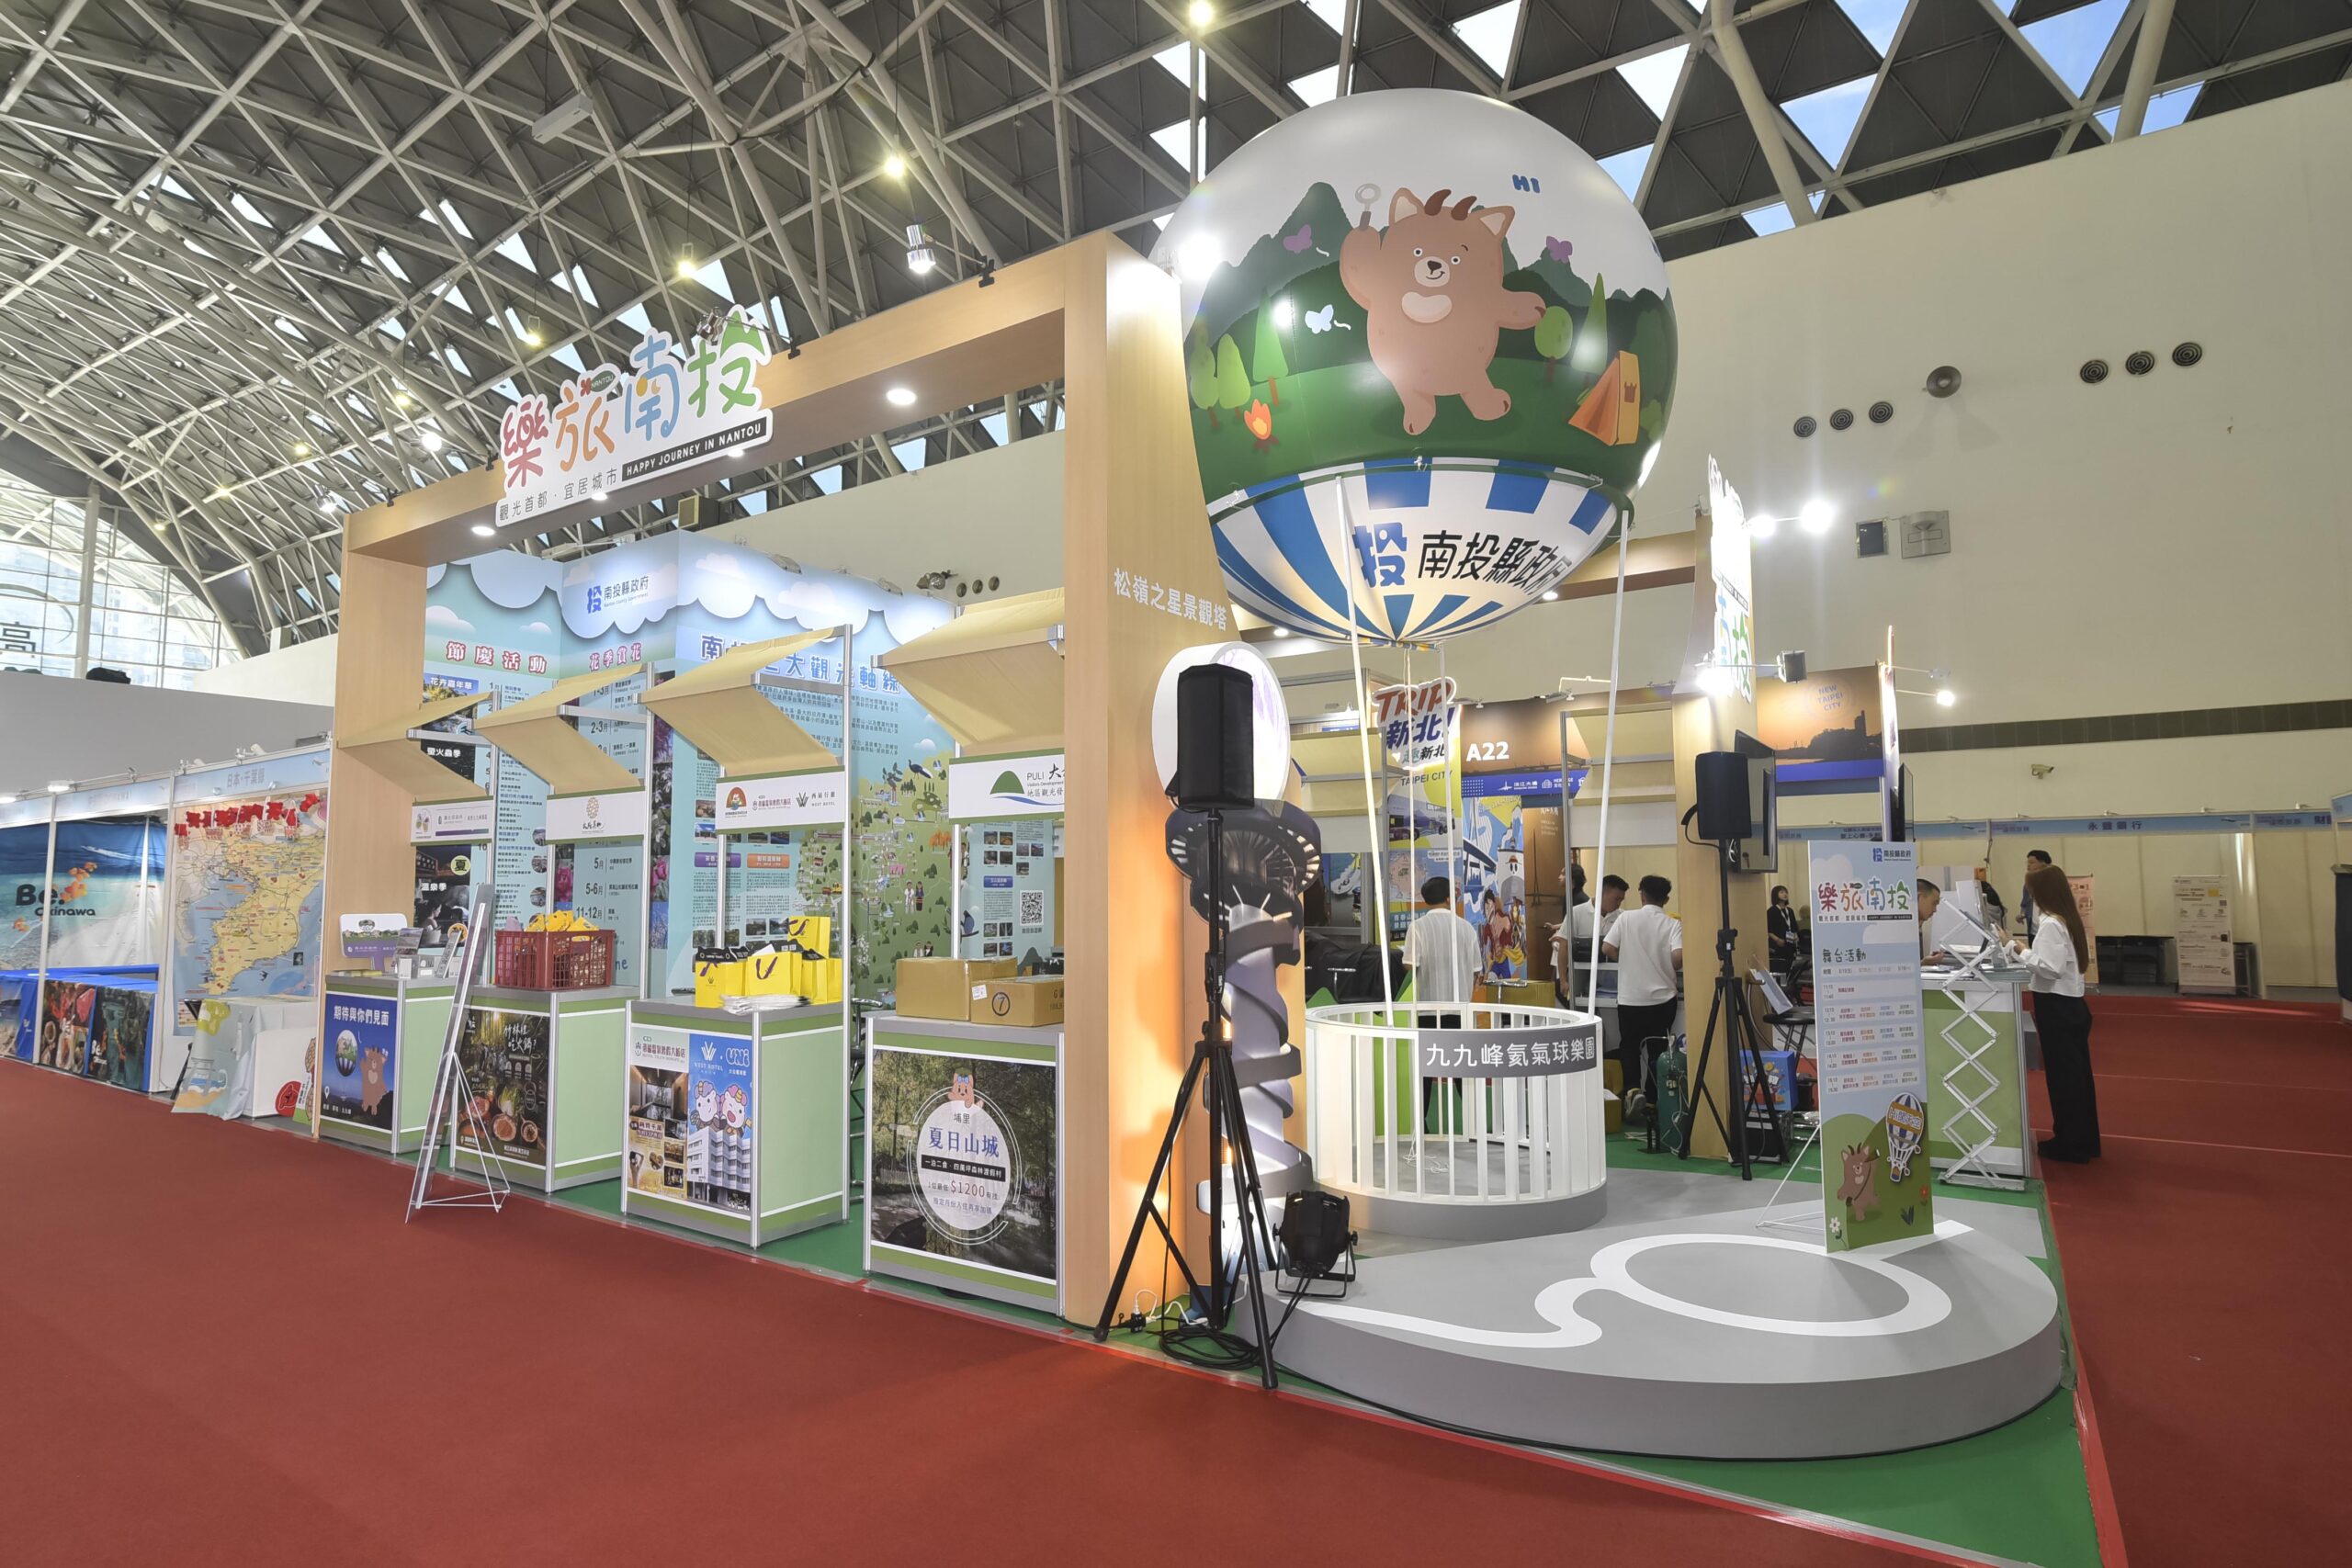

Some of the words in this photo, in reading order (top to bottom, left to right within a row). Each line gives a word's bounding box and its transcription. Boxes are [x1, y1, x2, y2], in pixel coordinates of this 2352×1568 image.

[1512, 175, 1540, 194] HI
[503, 310, 766, 489] 樂旅南投
[627, 458, 656, 476] HAPPY
[658, 443, 701, 466] JOURNEY
[704, 437, 715, 451] IN
[718, 423, 762, 446] NANTOU
[604, 576, 649, 601] 南投縣政府
[1114, 568, 1227, 631] 松嶺之星景觀塔
[447, 641, 547, 674] 節慶活動
[589, 642, 642, 671] 花季賞花
[1817, 692, 1843, 704] TAIPEI
[1818, 684, 1837, 694] NEW
[1374, 682, 1452, 723] TRIP
[1824, 701, 1841, 712] CITY
[426, 747, 461, 758] 螢火蟲季
[1466, 741, 1510, 762] A22
[1026, 772, 1045, 781] PULI
[1048, 763, 1066, 780] 大
[1401, 773, 1430, 787] TAIPEI
[421, 883, 447, 892] 溫泉季
[585, 882, 604, 896] 5-6月
[1818, 877, 1911, 912] 樂旅南投
[576, 907, 603, 919] 11-12月
[1823, 948, 1867, 964] 舞台活動
[996, 996, 1007, 1012] 7
[334, 1005, 390, 1026] 期待與你們見面
[1426, 1036, 1595, 1067] 九九峰氦氣球樂園
[954, 1112, 970, 1124] 埔里
[928, 1126, 1000, 1157] 夏日山城
[950, 1179, 986, 1198] $1200
